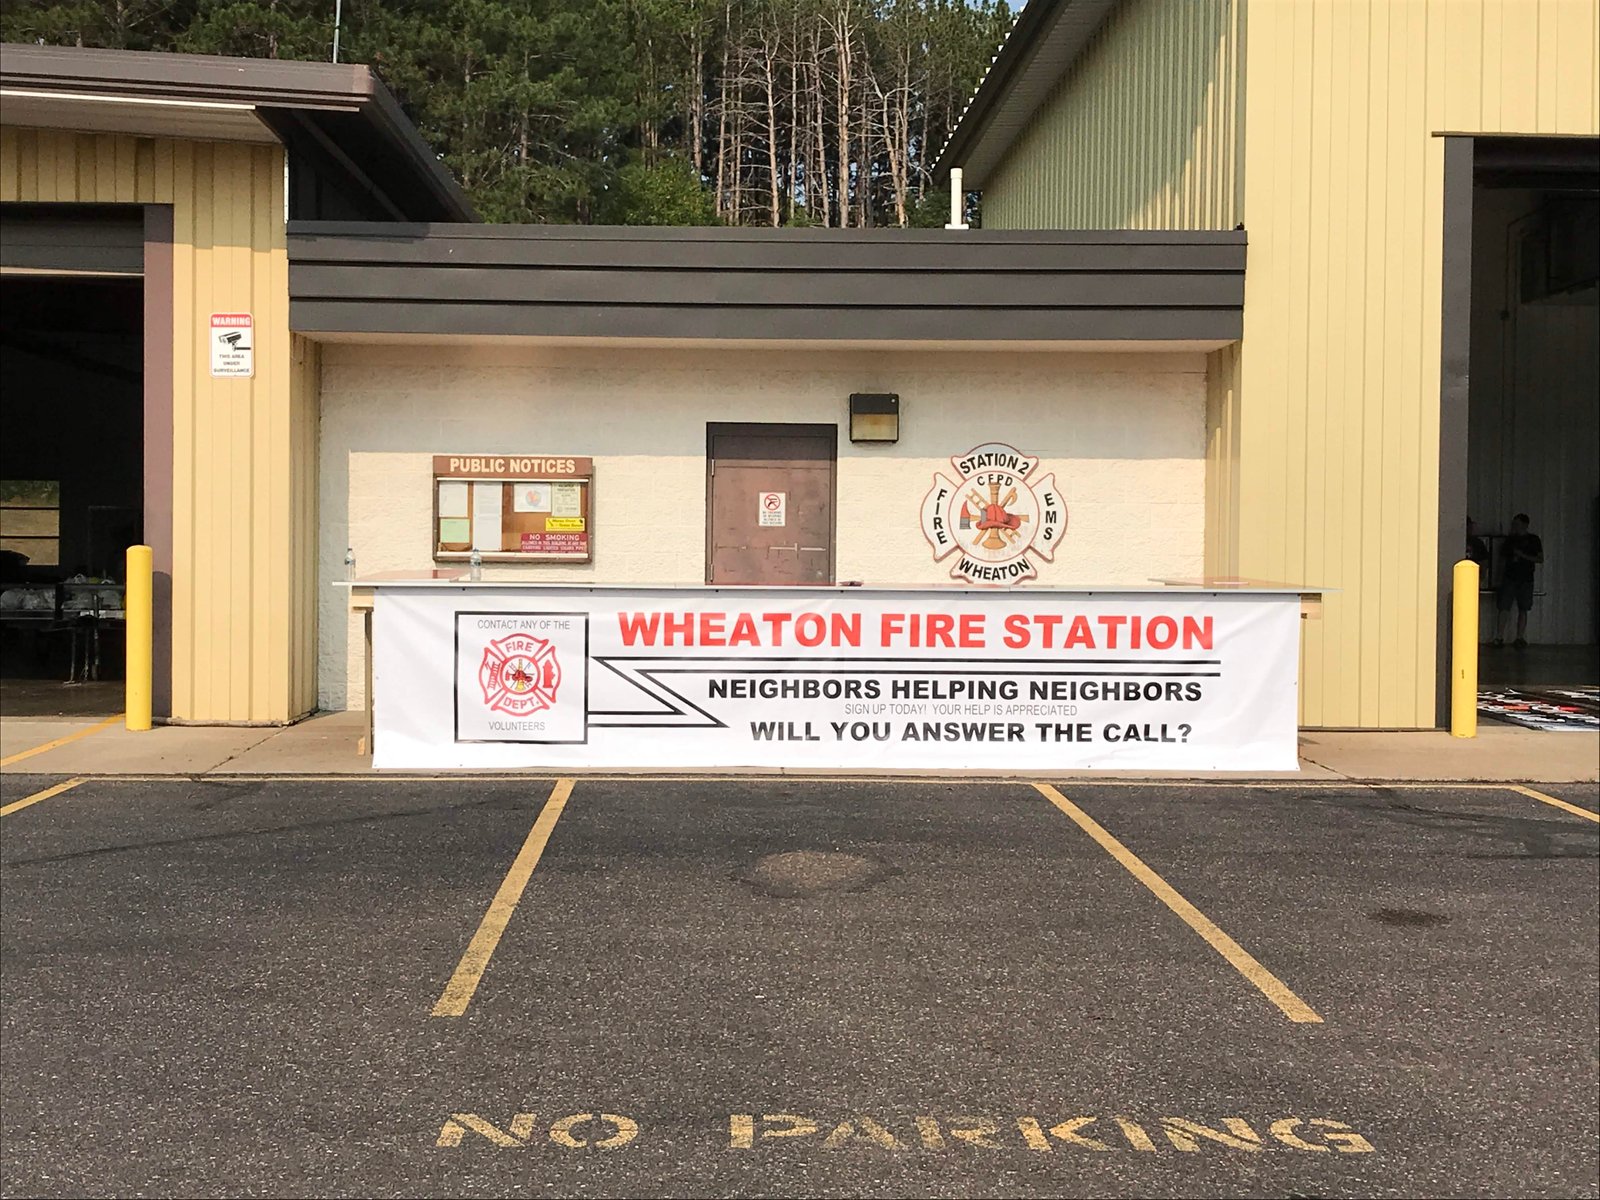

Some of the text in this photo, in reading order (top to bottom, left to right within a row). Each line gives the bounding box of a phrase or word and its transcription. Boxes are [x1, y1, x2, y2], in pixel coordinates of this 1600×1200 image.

[212, 316, 250, 326] WARNING
[450, 458, 576, 474] PUBLIC NOTICES
[960, 453, 1030, 475] STATION 2
[933, 488, 948, 544] FIRE
[1044, 492, 1057, 540] EMS
[958, 558, 1030, 580] WHEATON
[478, 620, 570, 630] CONTACT ANY OF THE
[618, 612, 1214, 650] WHEATON FIRE STATION
[504, 640, 534, 653] FIRE
[708, 679, 1202, 701] NEIGHBORS HELPING NEIGHBORS
[502, 696, 540, 710] DEPT.
[844, 704, 1078, 716] SIGN UP TODAY! YOUR HELP IS APPRECIATED
[488, 721, 546, 730] VOLUNTEERS
[750, 722, 1192, 742] WILL YOU ANSWER THE CALL?
[436, 1112, 1375, 1153] NO PARKING
